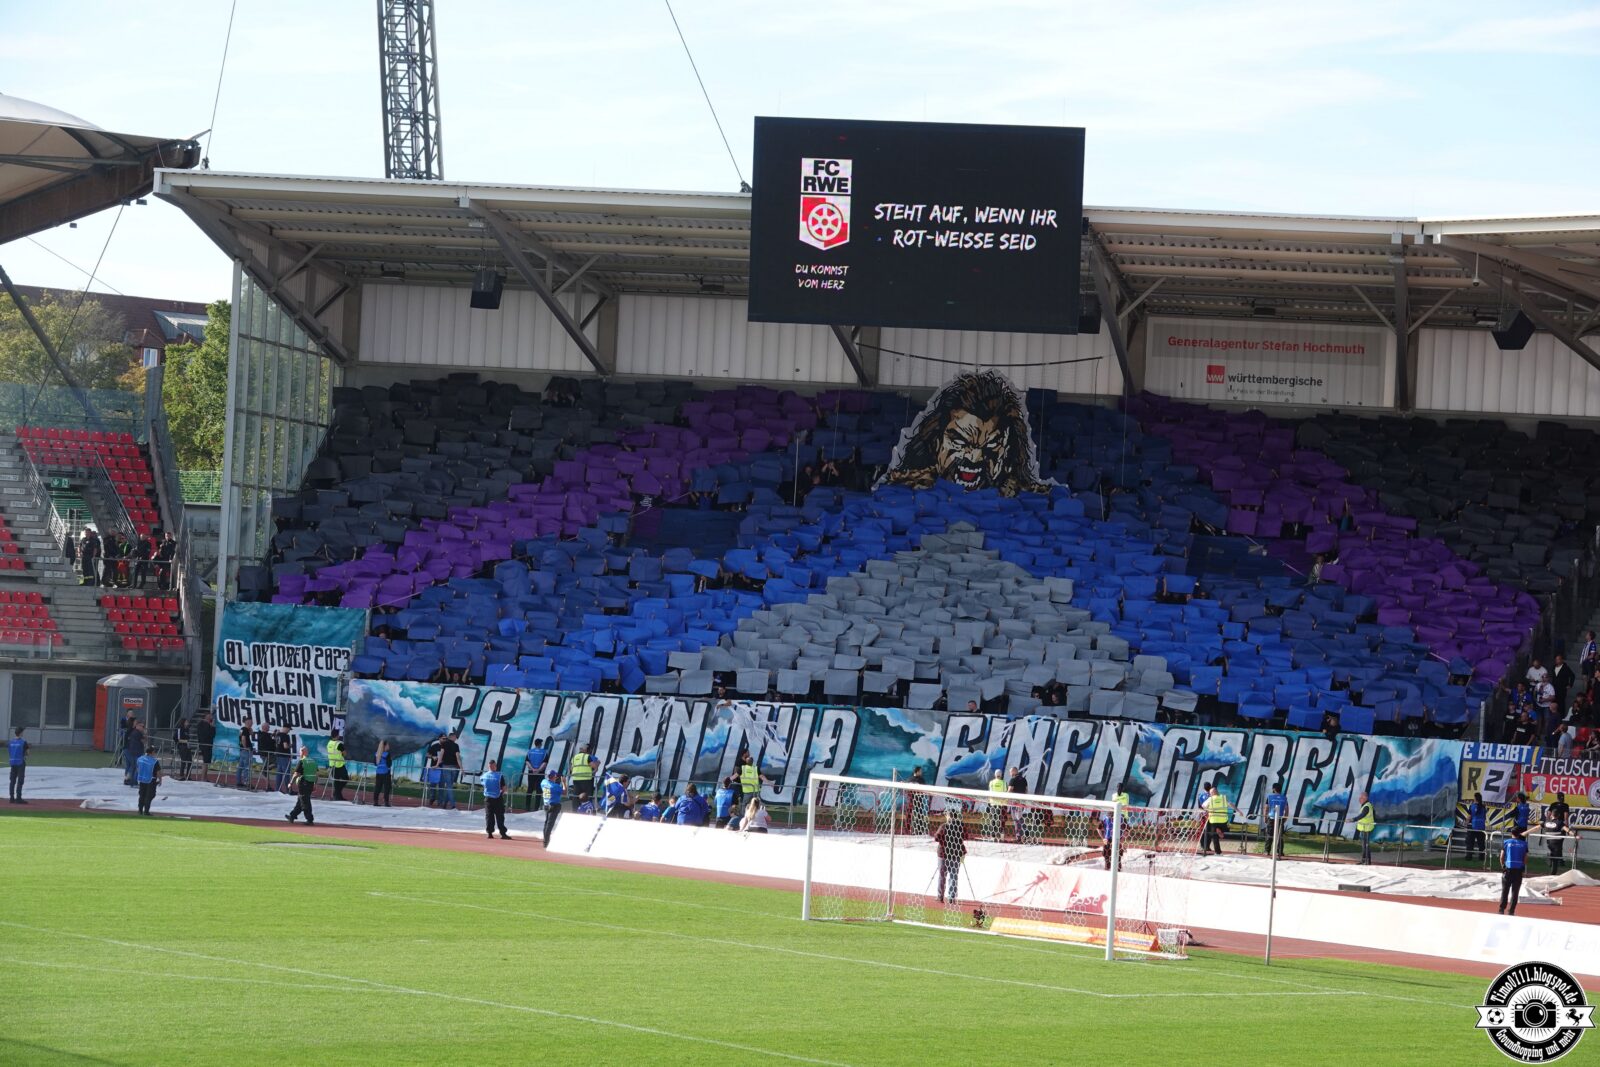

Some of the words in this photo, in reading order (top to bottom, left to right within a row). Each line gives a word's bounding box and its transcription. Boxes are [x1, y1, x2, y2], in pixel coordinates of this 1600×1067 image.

[813, 160, 840, 176] FC
[803, 176, 849, 193] RWE
[874, 203, 926, 221] STEHT
[929, 205, 968, 224] AUF,
[975, 206, 1025, 225] WENN
[1030, 209, 1058, 228] IHR
[892, 229, 994, 249] ROT-WEISSE
[999, 233, 1037, 250] SEID
[795, 264, 809, 274] DU
[810, 264, 849, 276] KOMMST
[798, 278, 819, 289] VOM
[821, 279, 845, 290] HERZ
[1167, 335, 1260, 351] Generalagentur
[1262, 339, 1300, 352] Stefan
[1303, 342, 1365, 355] Hochmuth
[1227, 373, 1324, 388] württembergische
[252, 643, 312, 672] OKTOBER
[314, 648, 350, 672] 2023
[251, 670, 317, 699] ALLEIN
[1549, 776, 1587, 796] GERA
